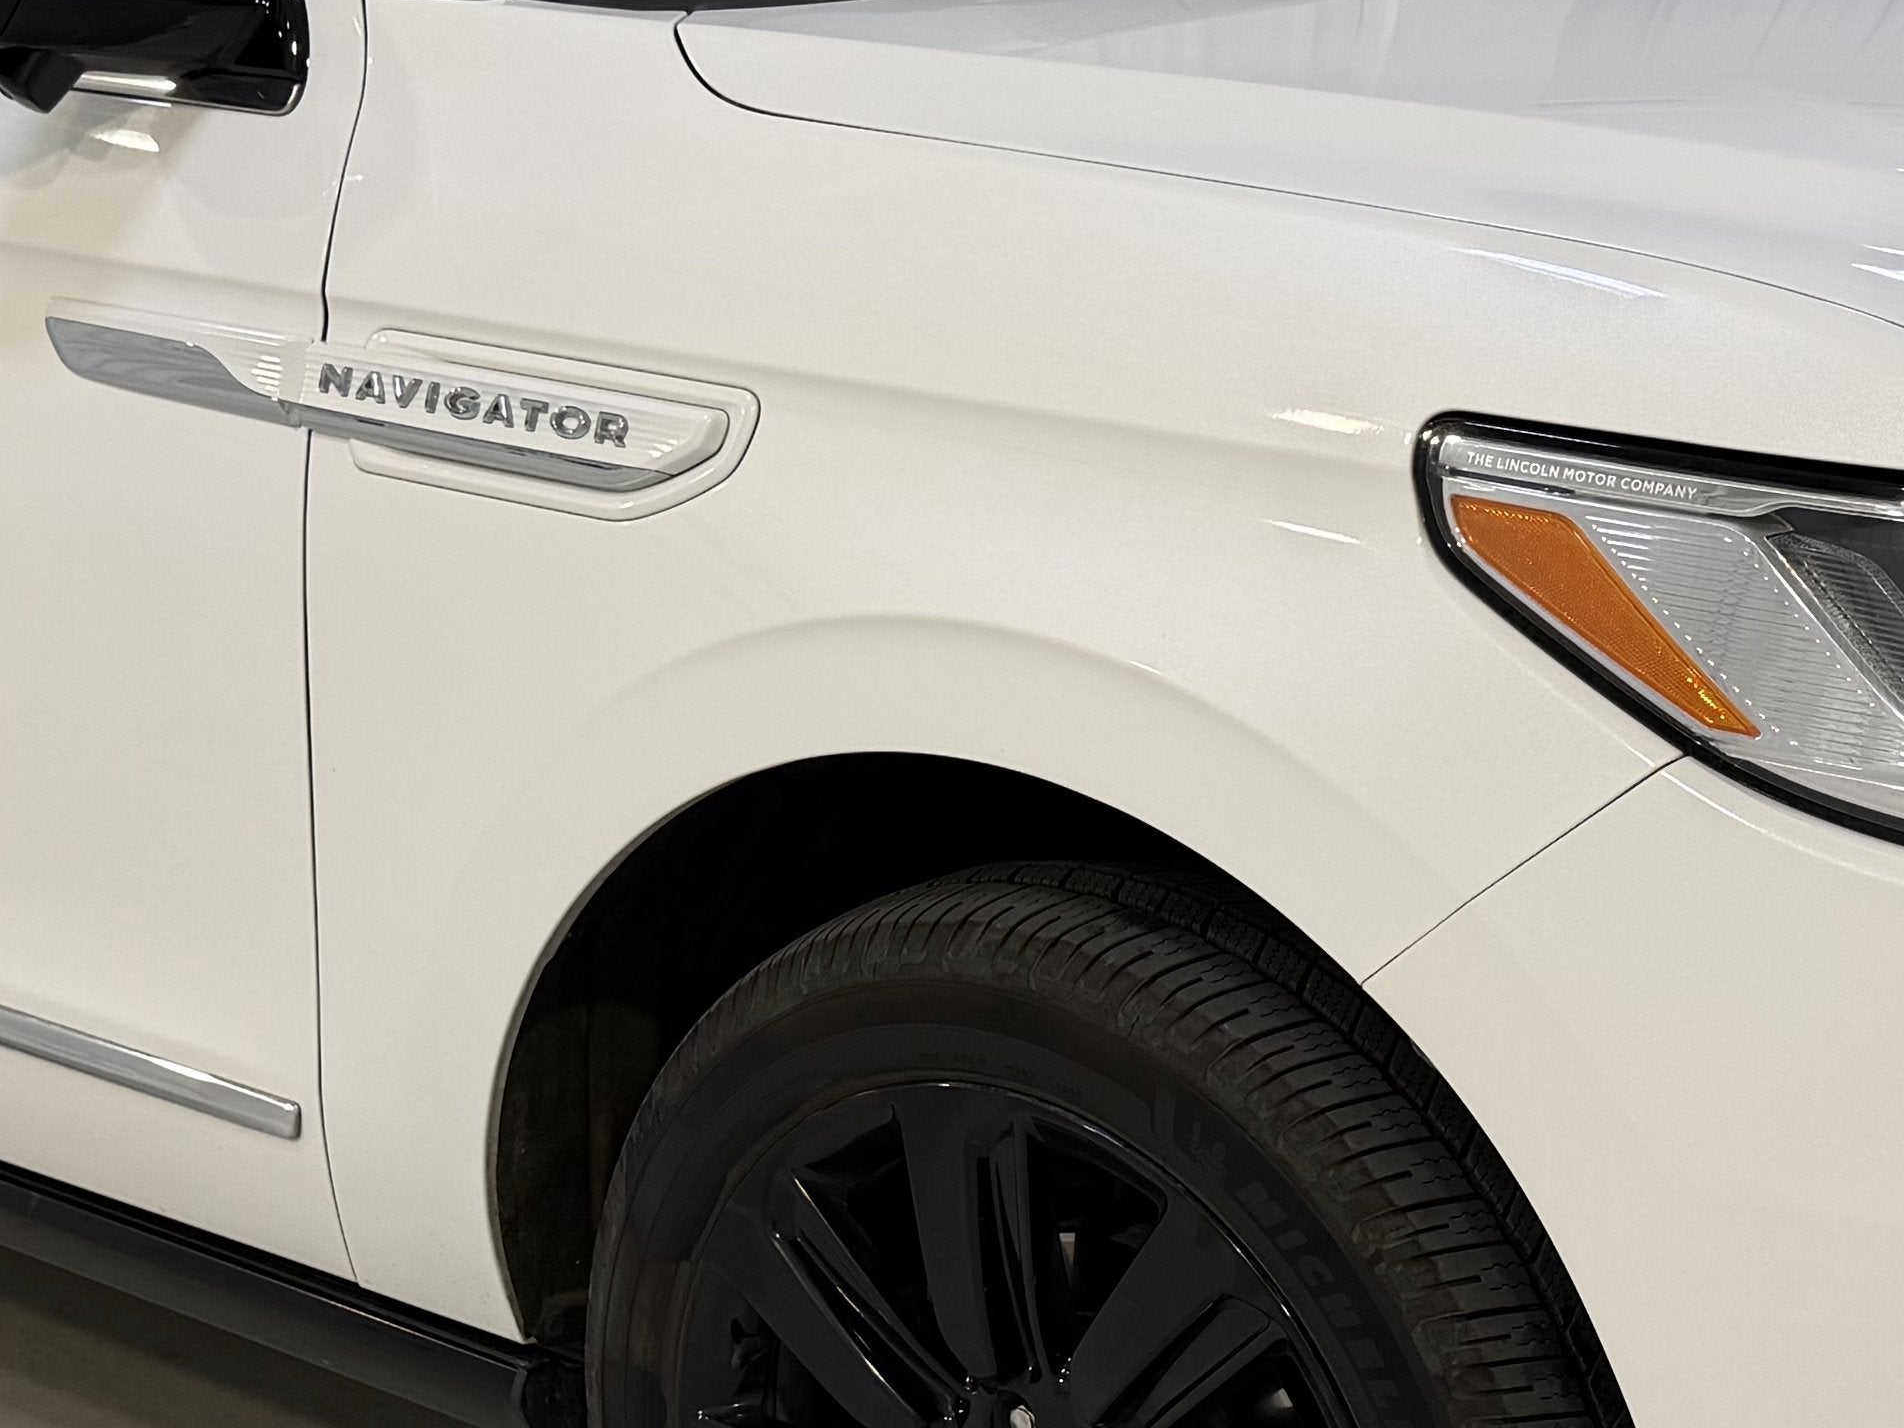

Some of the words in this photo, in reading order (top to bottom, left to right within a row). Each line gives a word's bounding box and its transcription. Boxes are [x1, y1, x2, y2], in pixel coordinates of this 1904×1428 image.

[318, 363, 629, 448] NAVIGATOR
[1467, 451, 1494, 468] THE
[1496, 457, 1560, 479] LINCOLN
[1562, 468, 1616, 488] MOTOR
[1620, 477, 1697, 499] COMPANY
